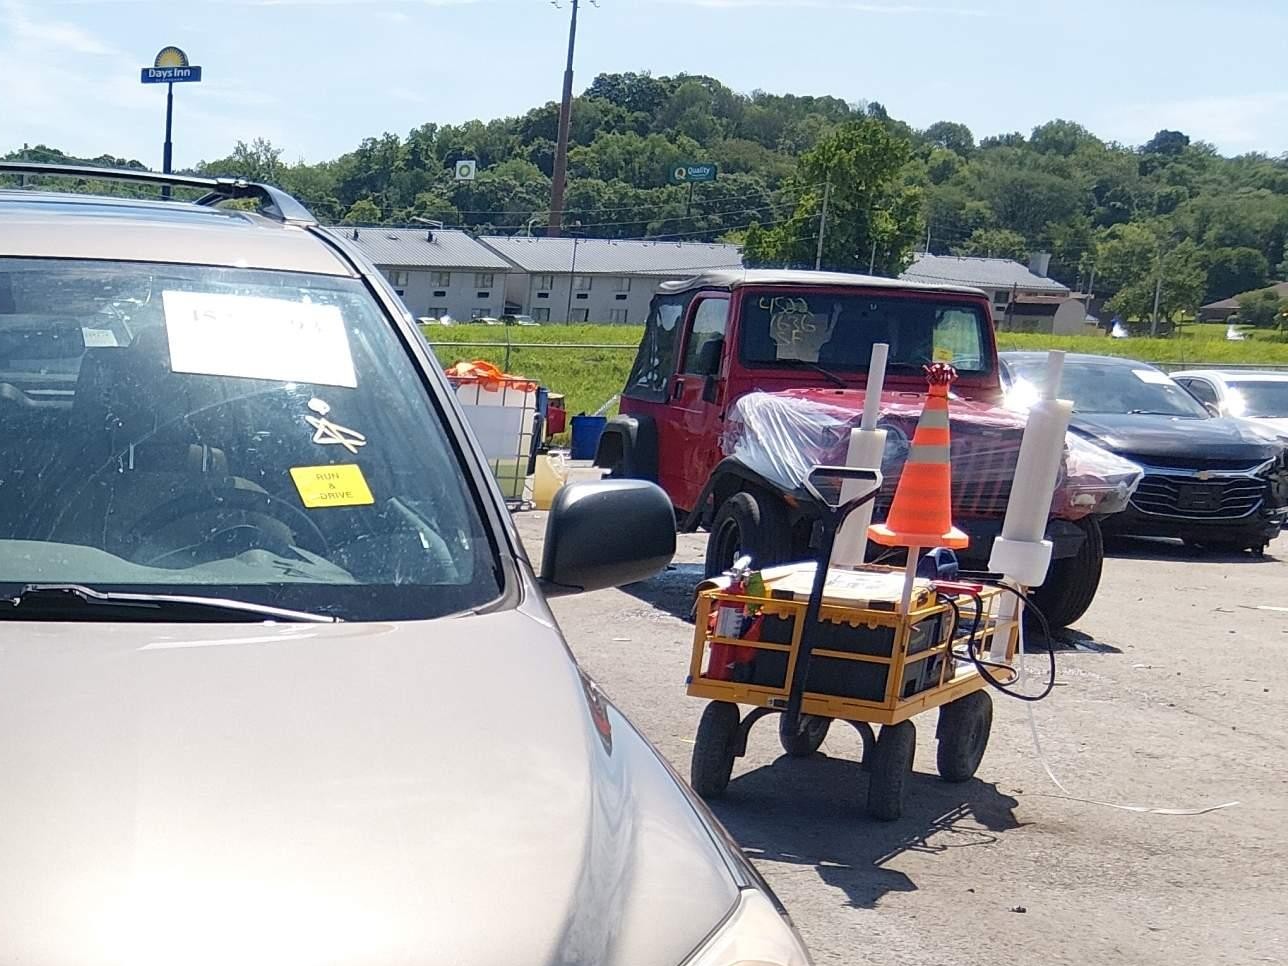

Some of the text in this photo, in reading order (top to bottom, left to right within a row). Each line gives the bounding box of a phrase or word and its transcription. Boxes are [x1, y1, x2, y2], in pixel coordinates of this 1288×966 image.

[148, 67, 191, 79] Days Inn
[687, 166, 711, 177] Quality
[315, 472, 340, 480] RUN
[319, 491, 353, 500] DRIVE
